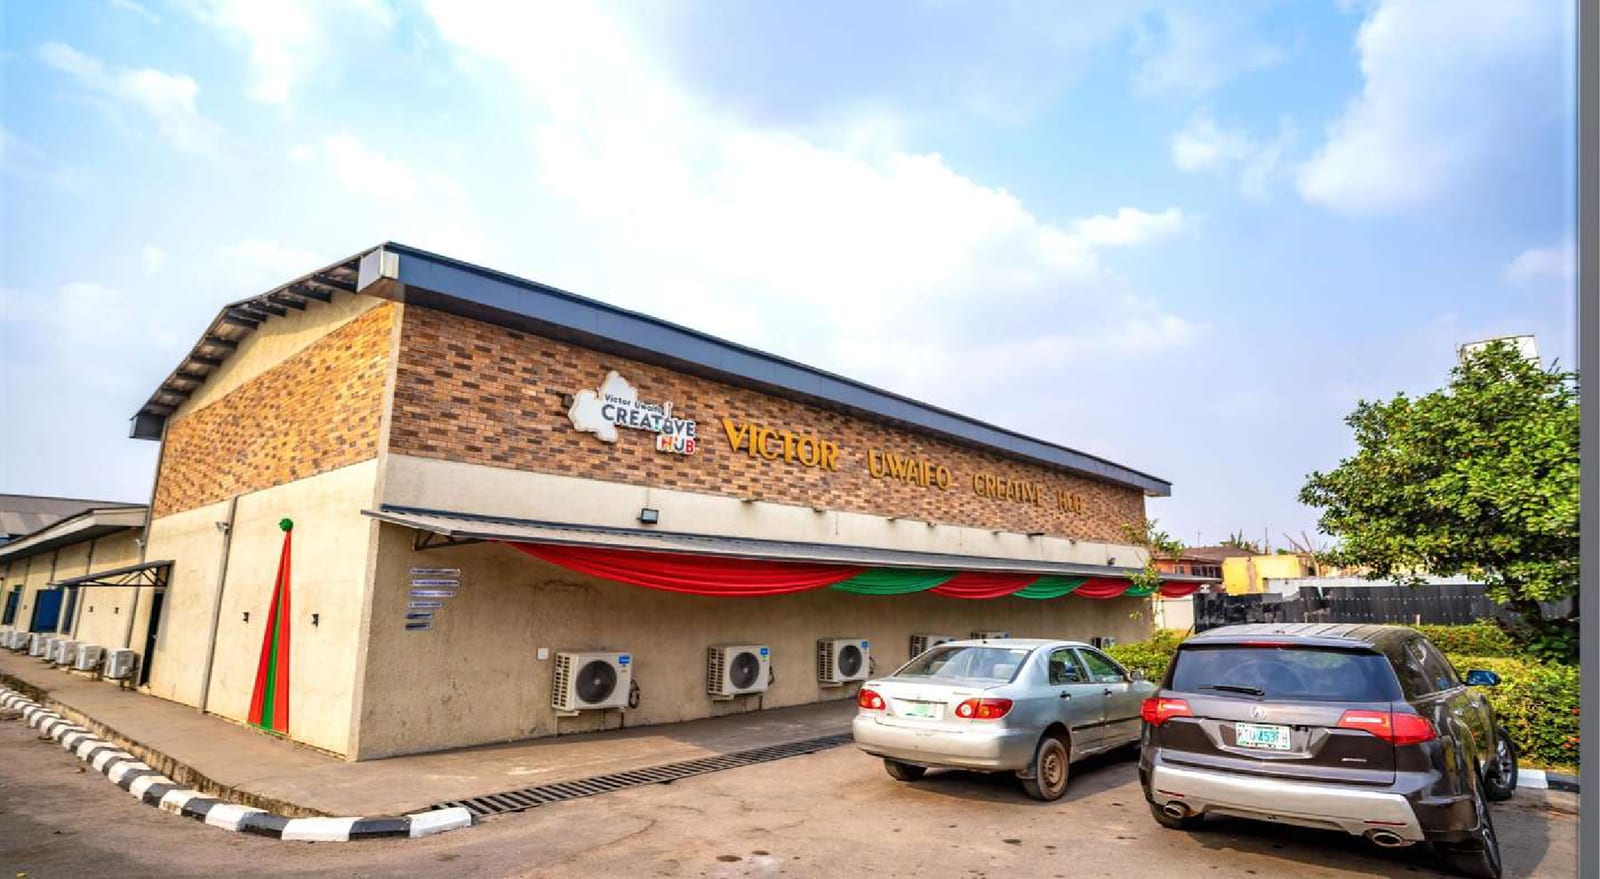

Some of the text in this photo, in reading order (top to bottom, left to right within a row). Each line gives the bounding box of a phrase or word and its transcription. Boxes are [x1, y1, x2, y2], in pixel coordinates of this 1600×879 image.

[605, 393, 631, 406] Victor
[661, 435, 696, 453] HUB
[722, 416, 1083, 515] VICTOR UWAIFO CREATIVE HUB
